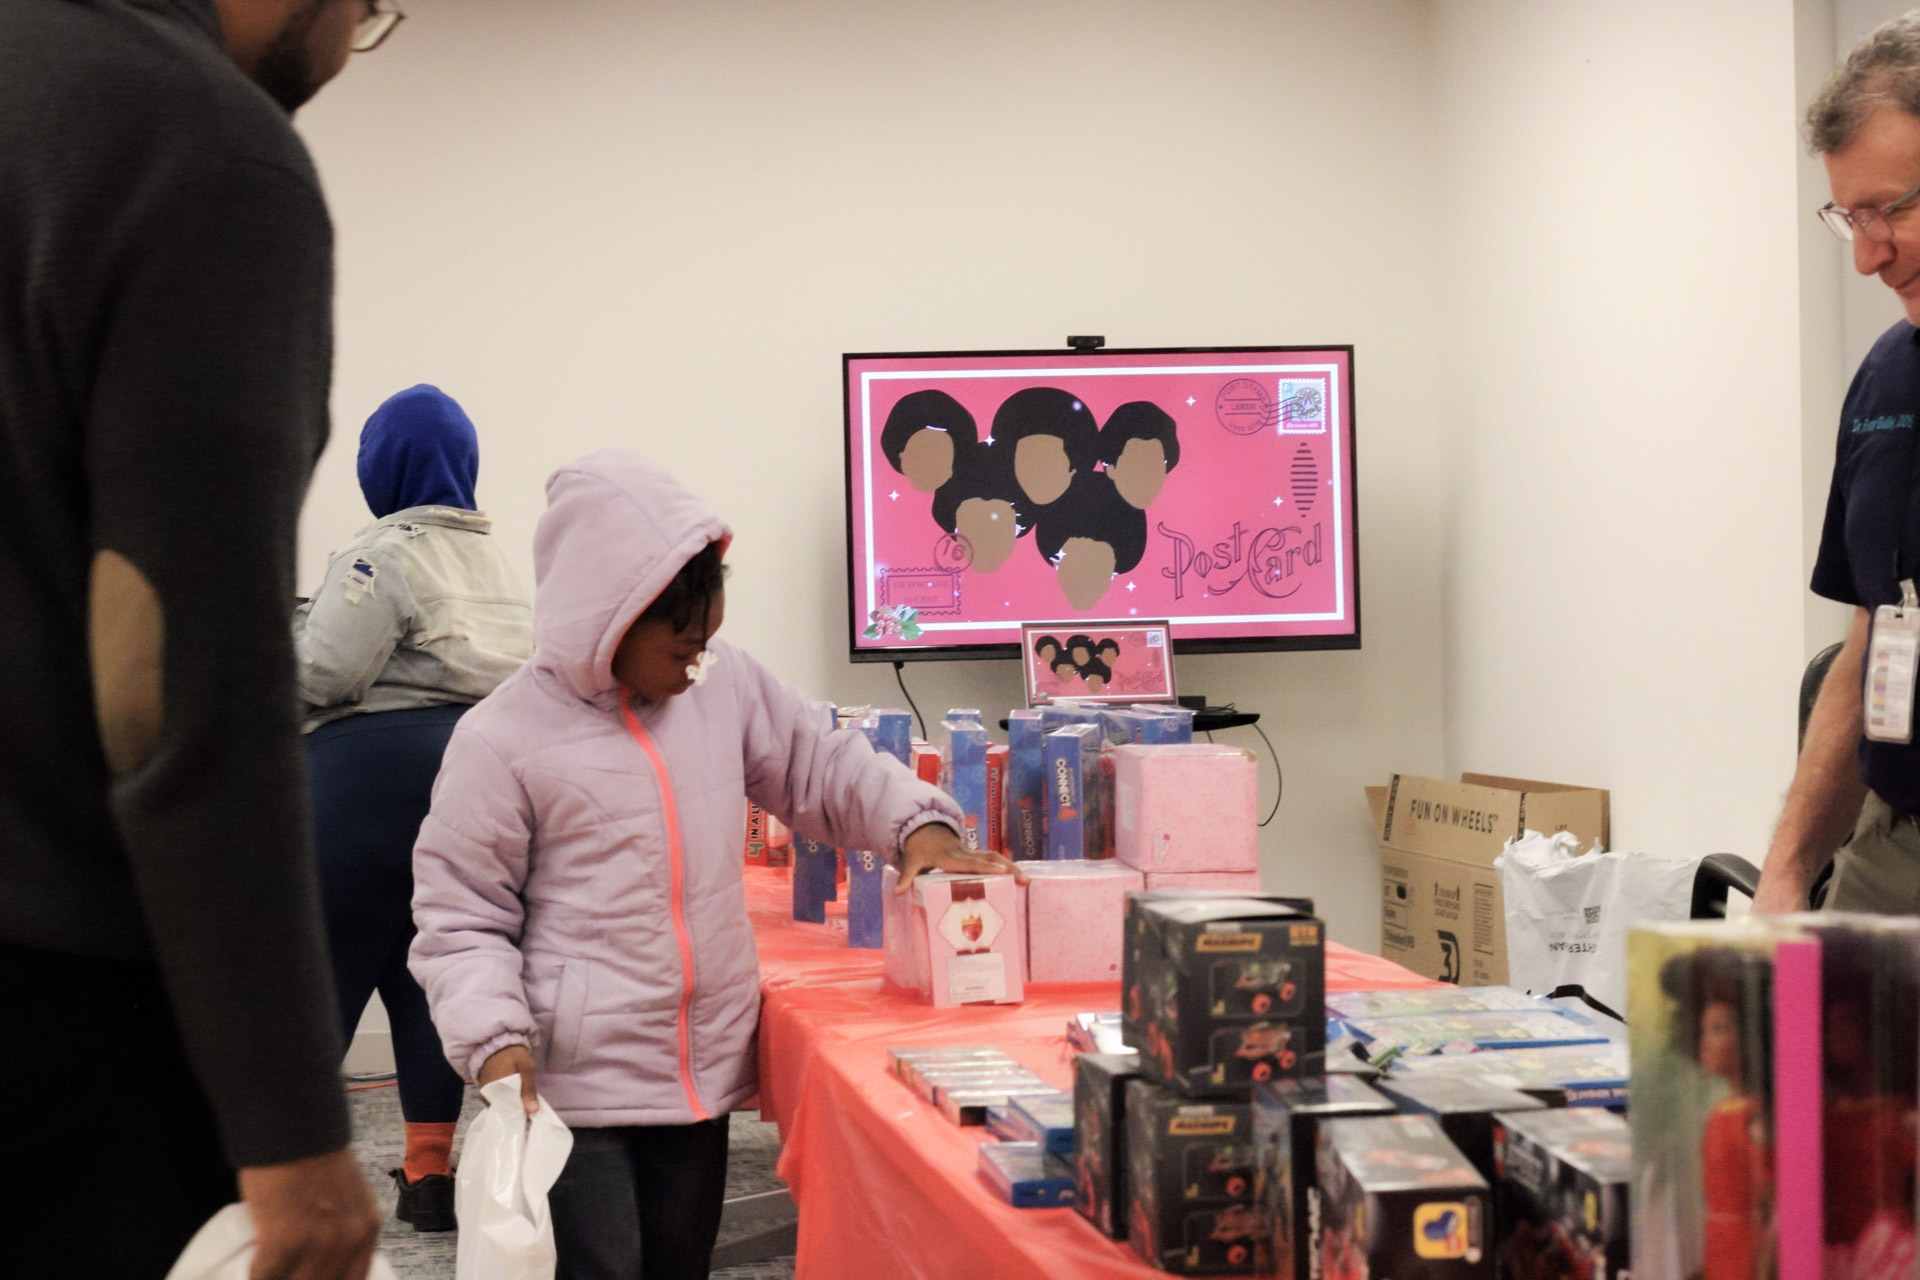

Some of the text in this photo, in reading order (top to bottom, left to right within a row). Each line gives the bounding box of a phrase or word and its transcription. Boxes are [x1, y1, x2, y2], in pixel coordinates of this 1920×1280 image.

[944, 539, 967, 561] 16
[1157, 521, 1322, 600] Post Card
[1056, 758, 1071, 807] CONNECT
[751, 817, 760, 825] A
[1410, 799, 1431, 821] FUN
[1434, 803, 1448, 823] ON
[750, 828, 760, 839] IN
[1022, 807, 1037, 856] CONNECT
